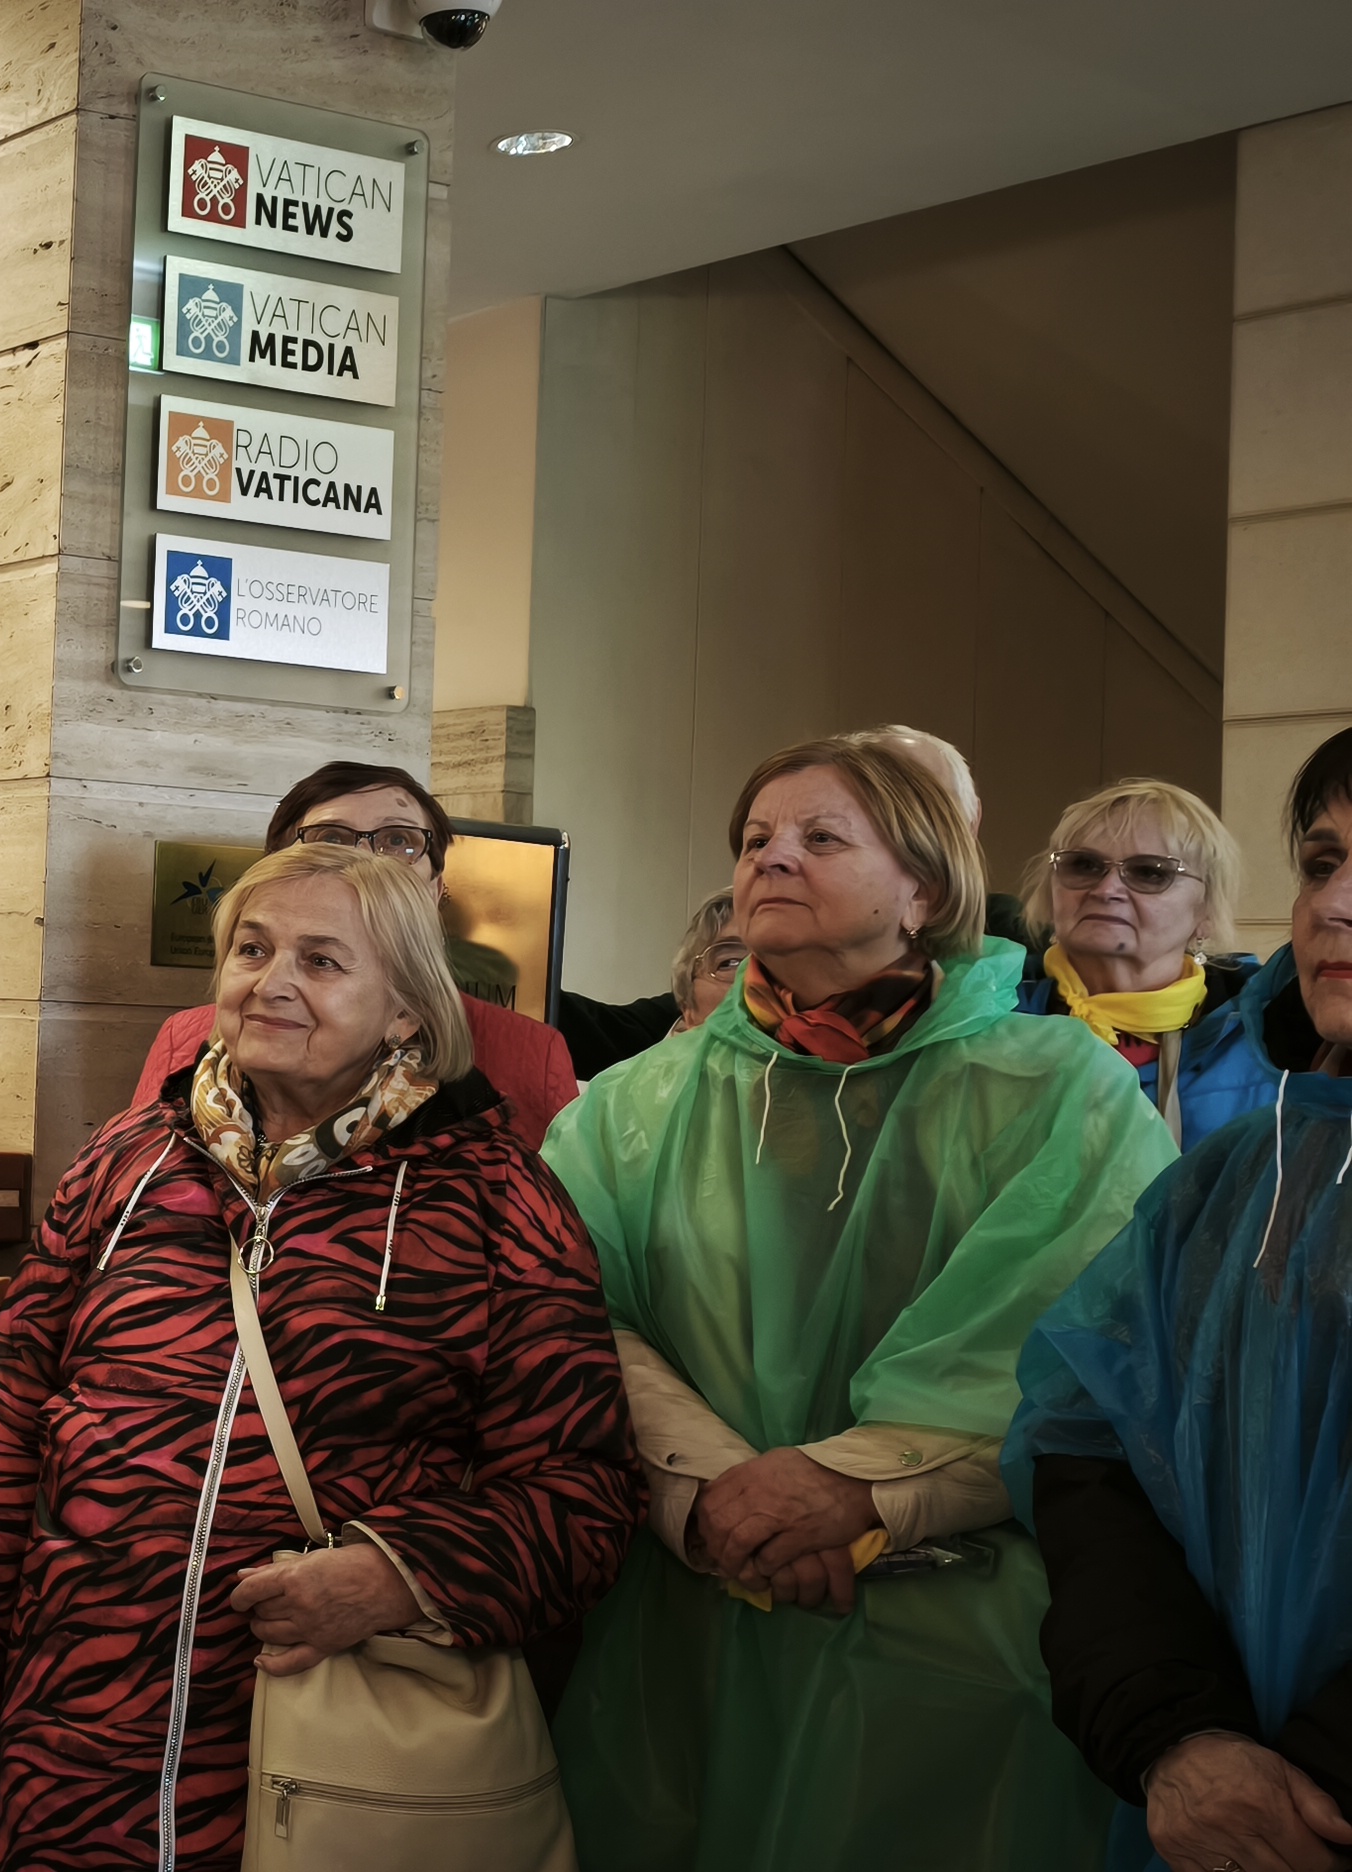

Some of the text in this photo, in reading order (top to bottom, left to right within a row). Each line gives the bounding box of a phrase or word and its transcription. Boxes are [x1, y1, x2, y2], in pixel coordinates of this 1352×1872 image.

[255, 153, 392, 212] VATICAN
[254, 192, 354, 242] NEWS
[250, 290, 386, 346] VATICAN
[248, 329, 359, 380] MEDIA
[235, 428, 338, 475] RADIO
[235, 467, 383, 515] VATICANA
[237, 578, 378, 614] L'OSSERVATORE
[235, 608, 322, 636] ROMANO
